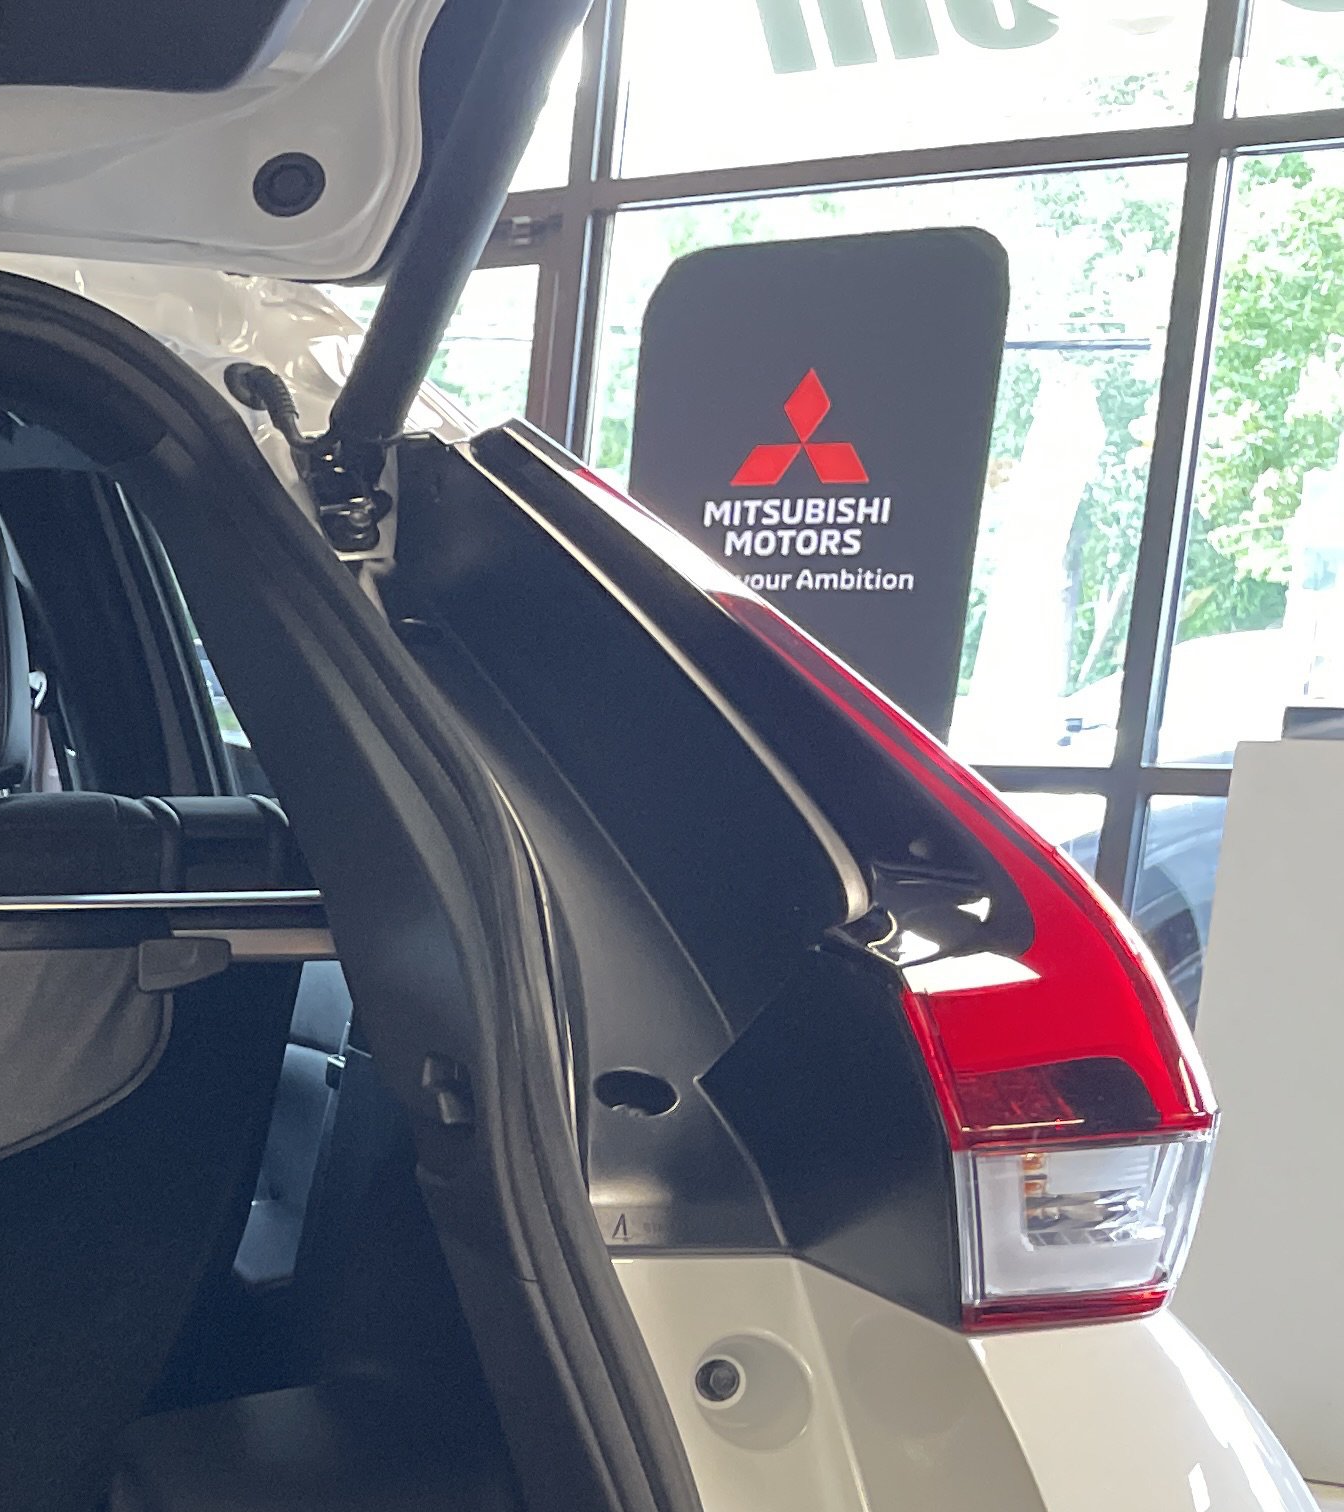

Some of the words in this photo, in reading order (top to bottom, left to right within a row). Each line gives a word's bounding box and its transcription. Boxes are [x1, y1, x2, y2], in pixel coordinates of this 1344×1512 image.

[703, 497, 892, 528] MITSUBISHI
[724, 528, 863, 556] MOTORS
[795, 568, 915, 592] Ambition
